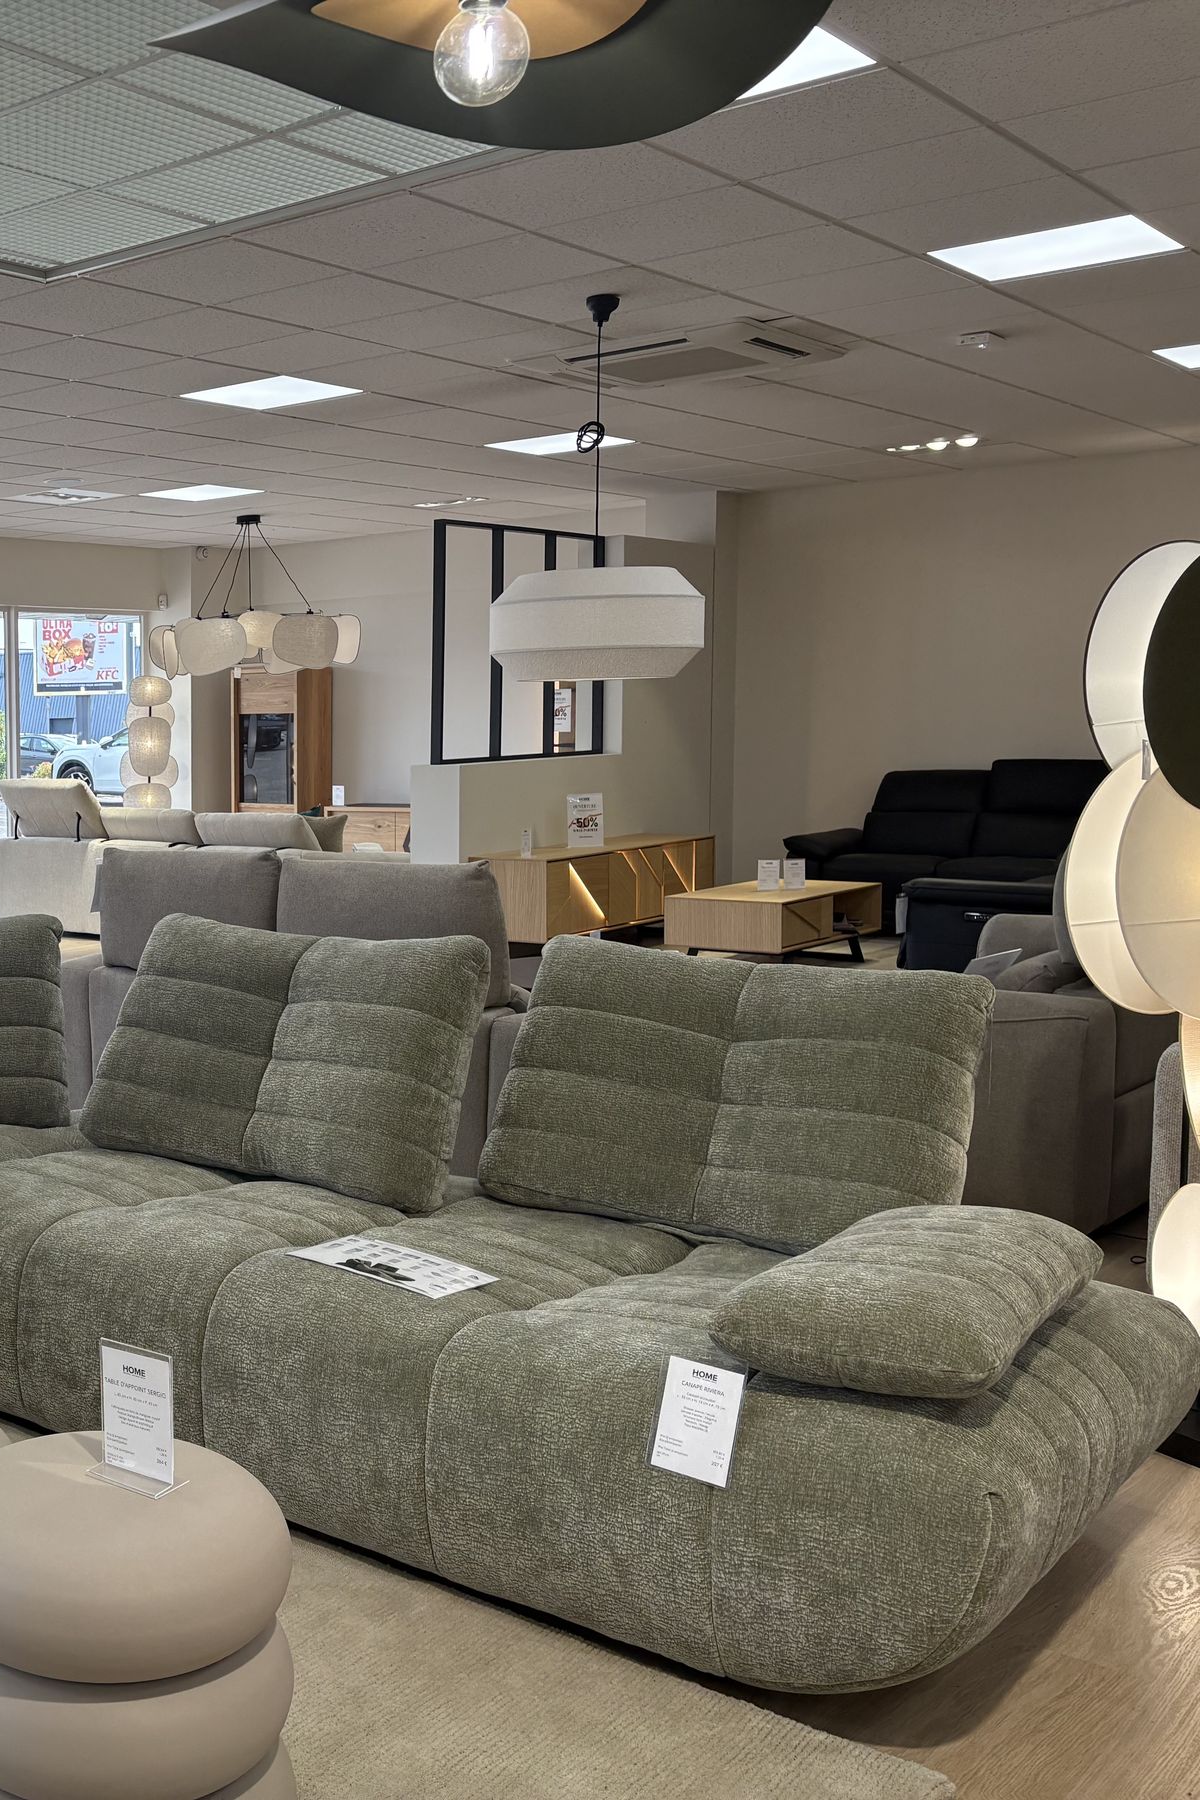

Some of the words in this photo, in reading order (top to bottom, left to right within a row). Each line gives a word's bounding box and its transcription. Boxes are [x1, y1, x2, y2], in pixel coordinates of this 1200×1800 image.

[42, 629, 72, 641] BOX
[96, 670, 119, 680] KFC
[572, 816, 598, 828] -50%
[122, 1364, 146, 1377] HOME
[692, 1368, 718, 1382] HOME
[104, 1376, 120, 1386] TABLE
